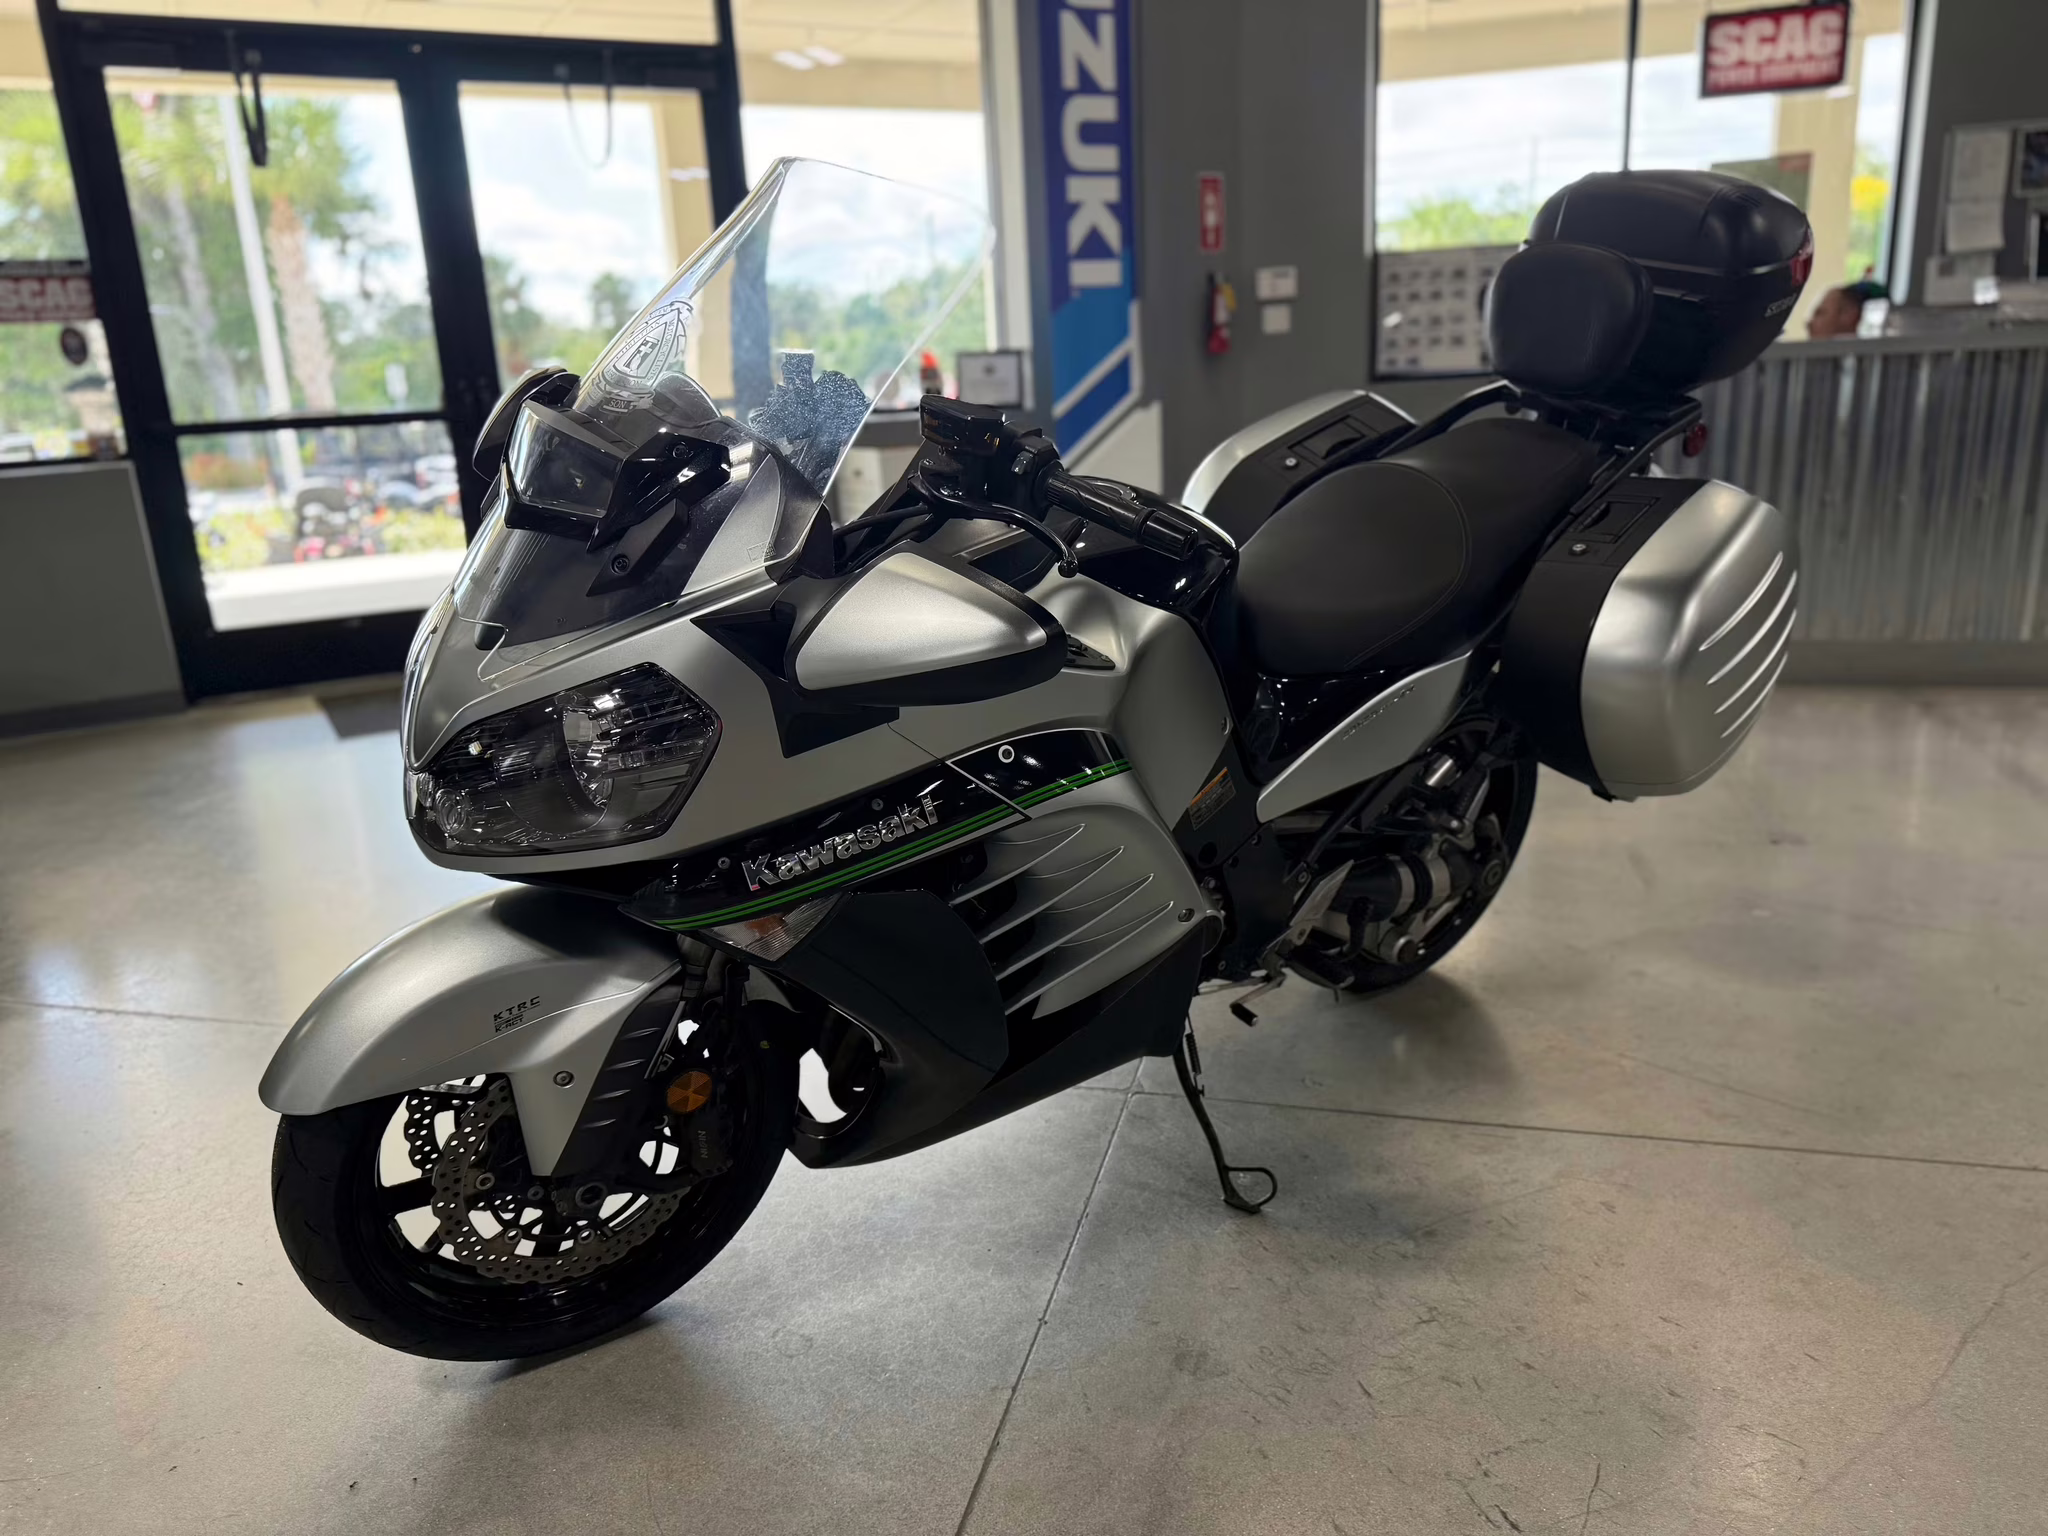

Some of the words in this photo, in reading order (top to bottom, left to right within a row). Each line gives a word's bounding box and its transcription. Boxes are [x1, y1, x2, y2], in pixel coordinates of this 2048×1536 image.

[1708, 11, 1842, 67] SCAG
[1060, 0, 1123, 287] ZUKI
[608, 399, 627, 409] SON
[741, 795, 939, 892] Kawasaki
[493, 995, 540, 1021] KTRC
